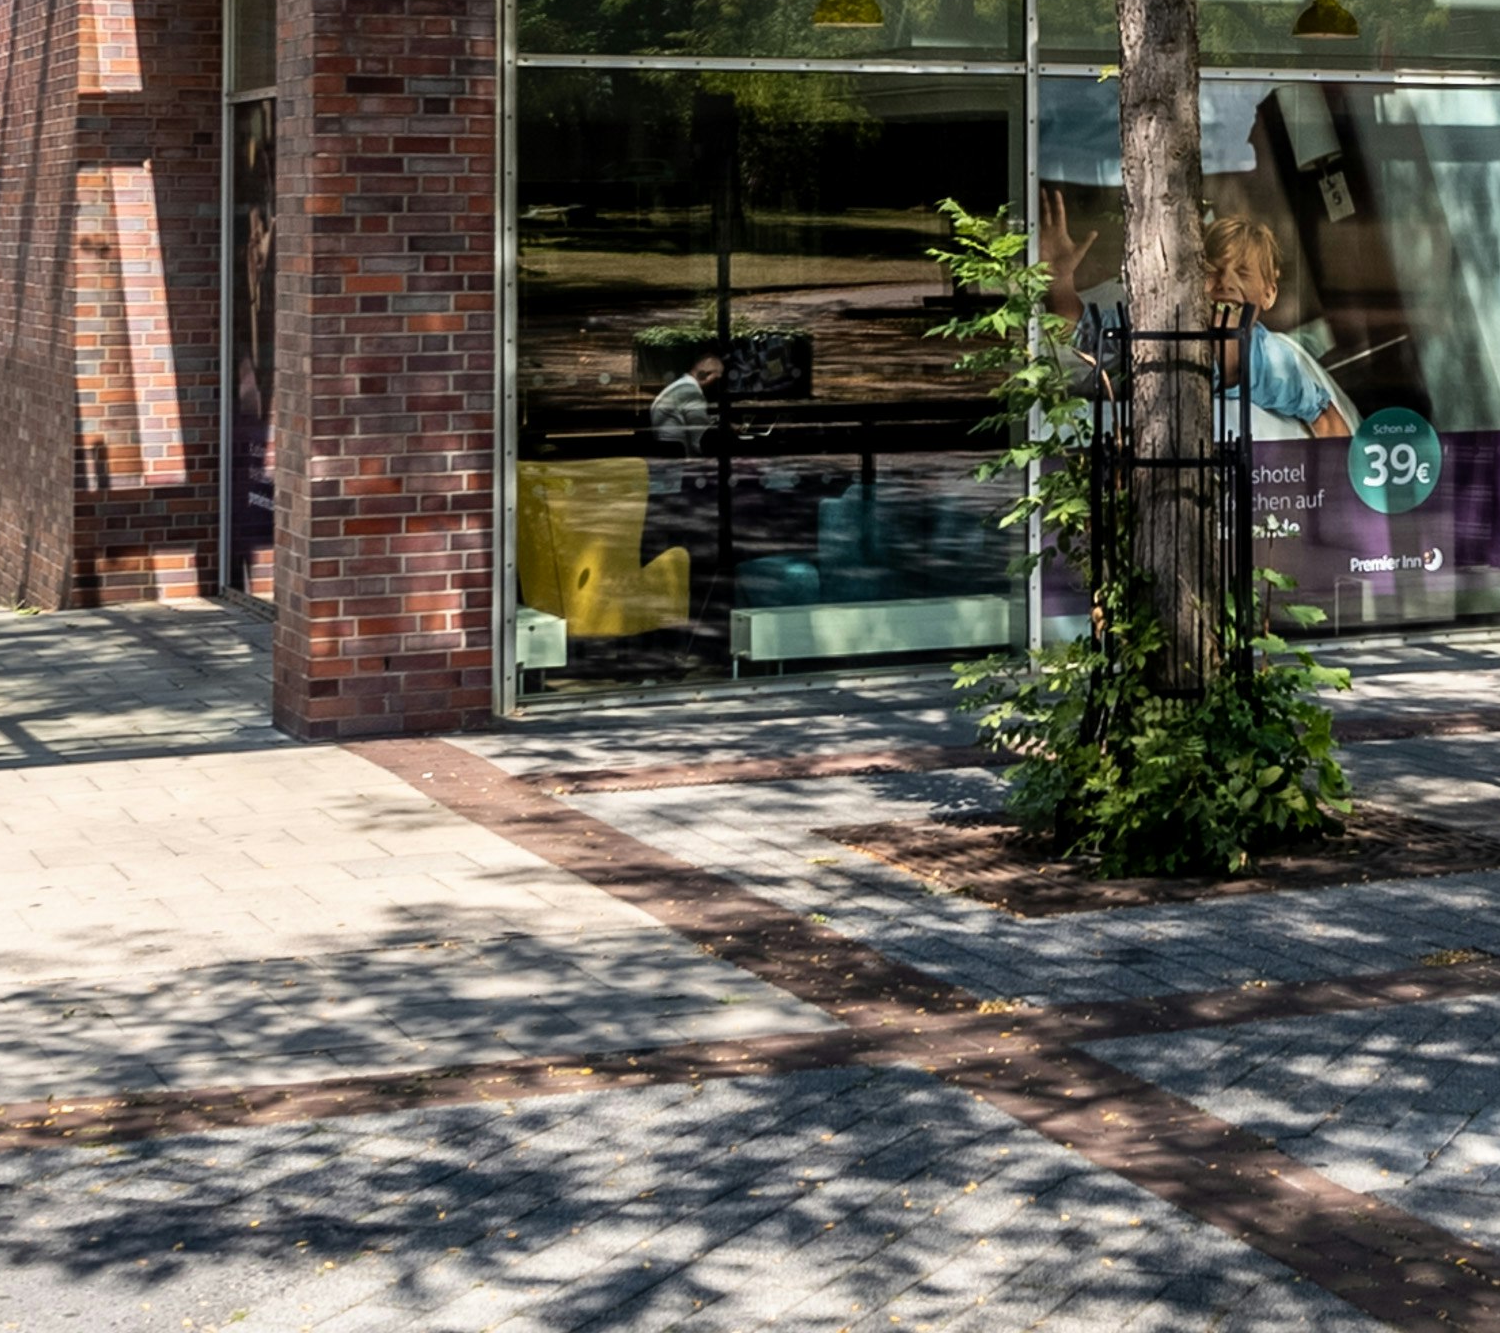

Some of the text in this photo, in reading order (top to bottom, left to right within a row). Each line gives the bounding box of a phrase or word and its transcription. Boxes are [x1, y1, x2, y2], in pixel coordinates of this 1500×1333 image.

[1373, 423, 1417, 435] Schon ab
[1363, 442, 1431, 487] 39€
[1295, 489, 1326, 510] auf
[1350, 553, 1422, 572] Premier Inn
